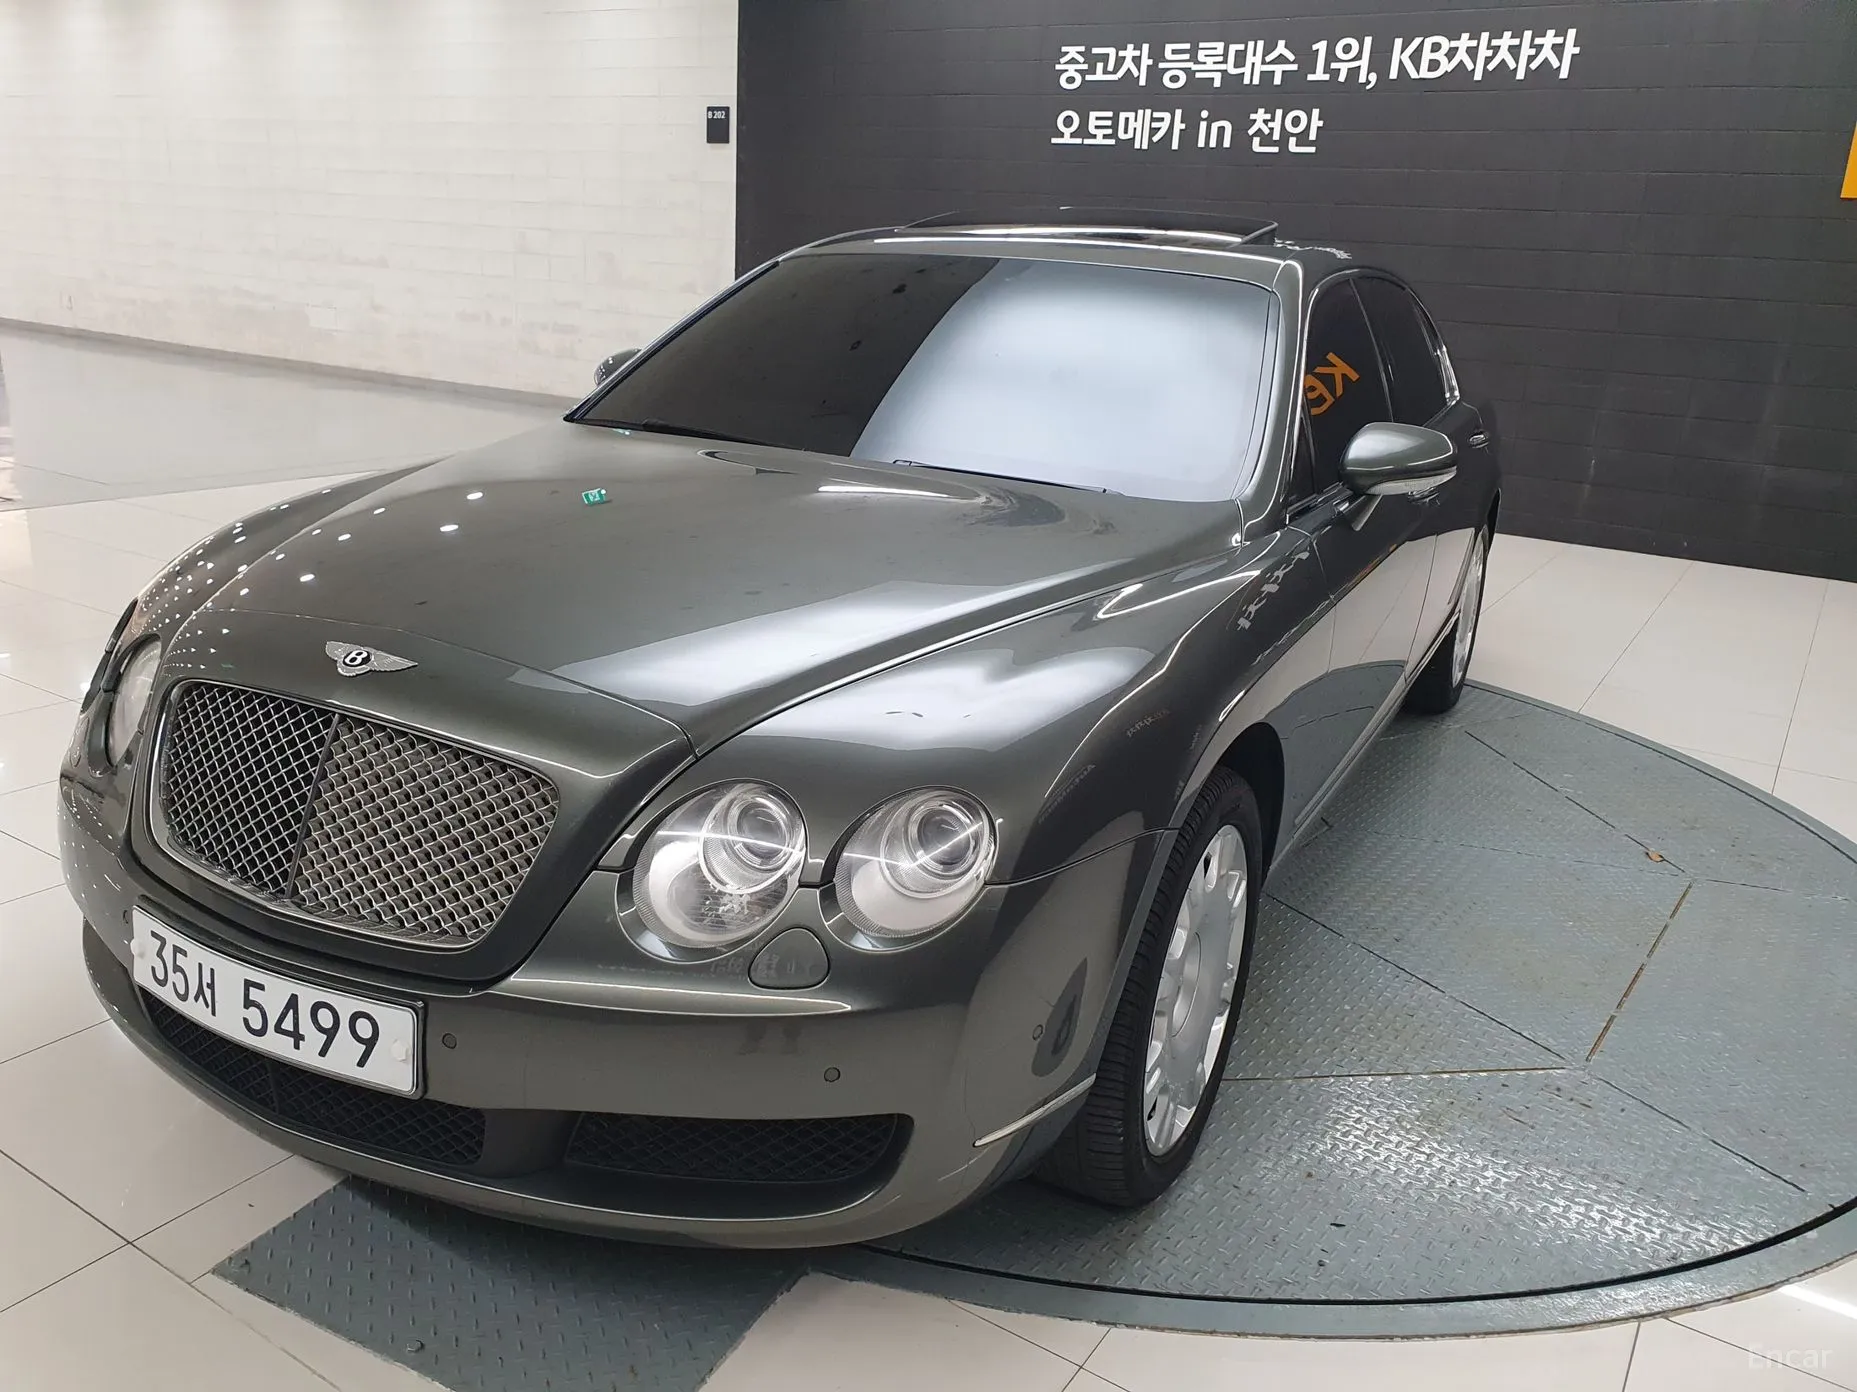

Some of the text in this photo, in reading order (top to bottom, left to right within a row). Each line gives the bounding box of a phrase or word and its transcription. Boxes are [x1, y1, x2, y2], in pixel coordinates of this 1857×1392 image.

[1055, 28, 1580, 89] 중고차 등록대수 1위, KB차차차
[713, 111, 726, 119] 202
[1051, 108, 1323, 153] 오토메카 in 천안
[150, 930, 380, 1069] 35서 5499
